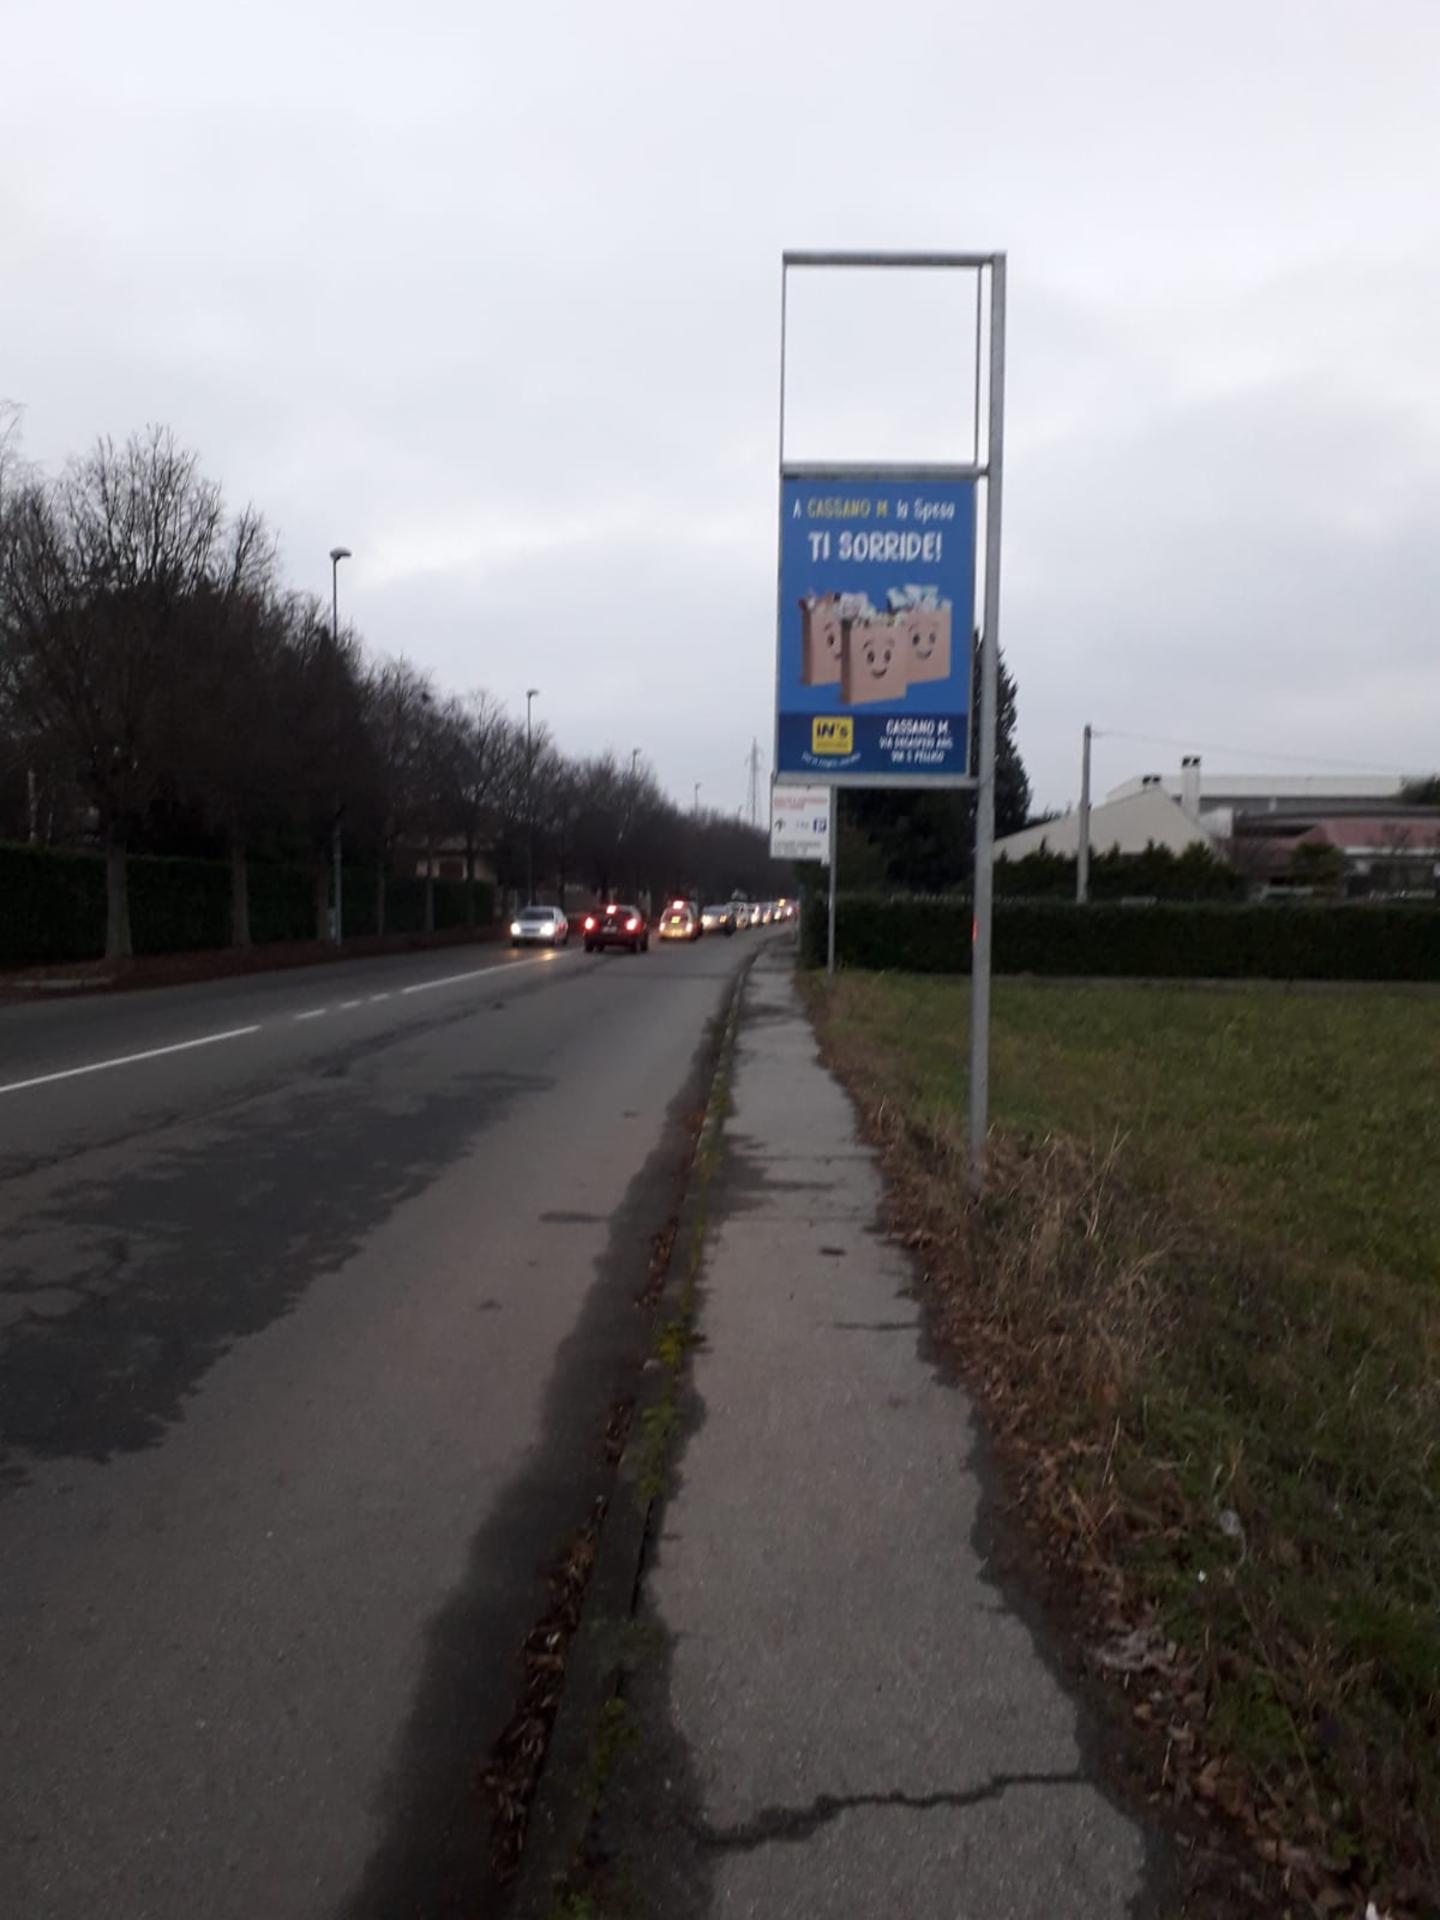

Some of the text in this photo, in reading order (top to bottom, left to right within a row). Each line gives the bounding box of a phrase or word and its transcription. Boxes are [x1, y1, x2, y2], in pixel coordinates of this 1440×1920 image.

[792, 498, 802, 519] A
[808, 530, 943, 563] TI SORRIDE!
